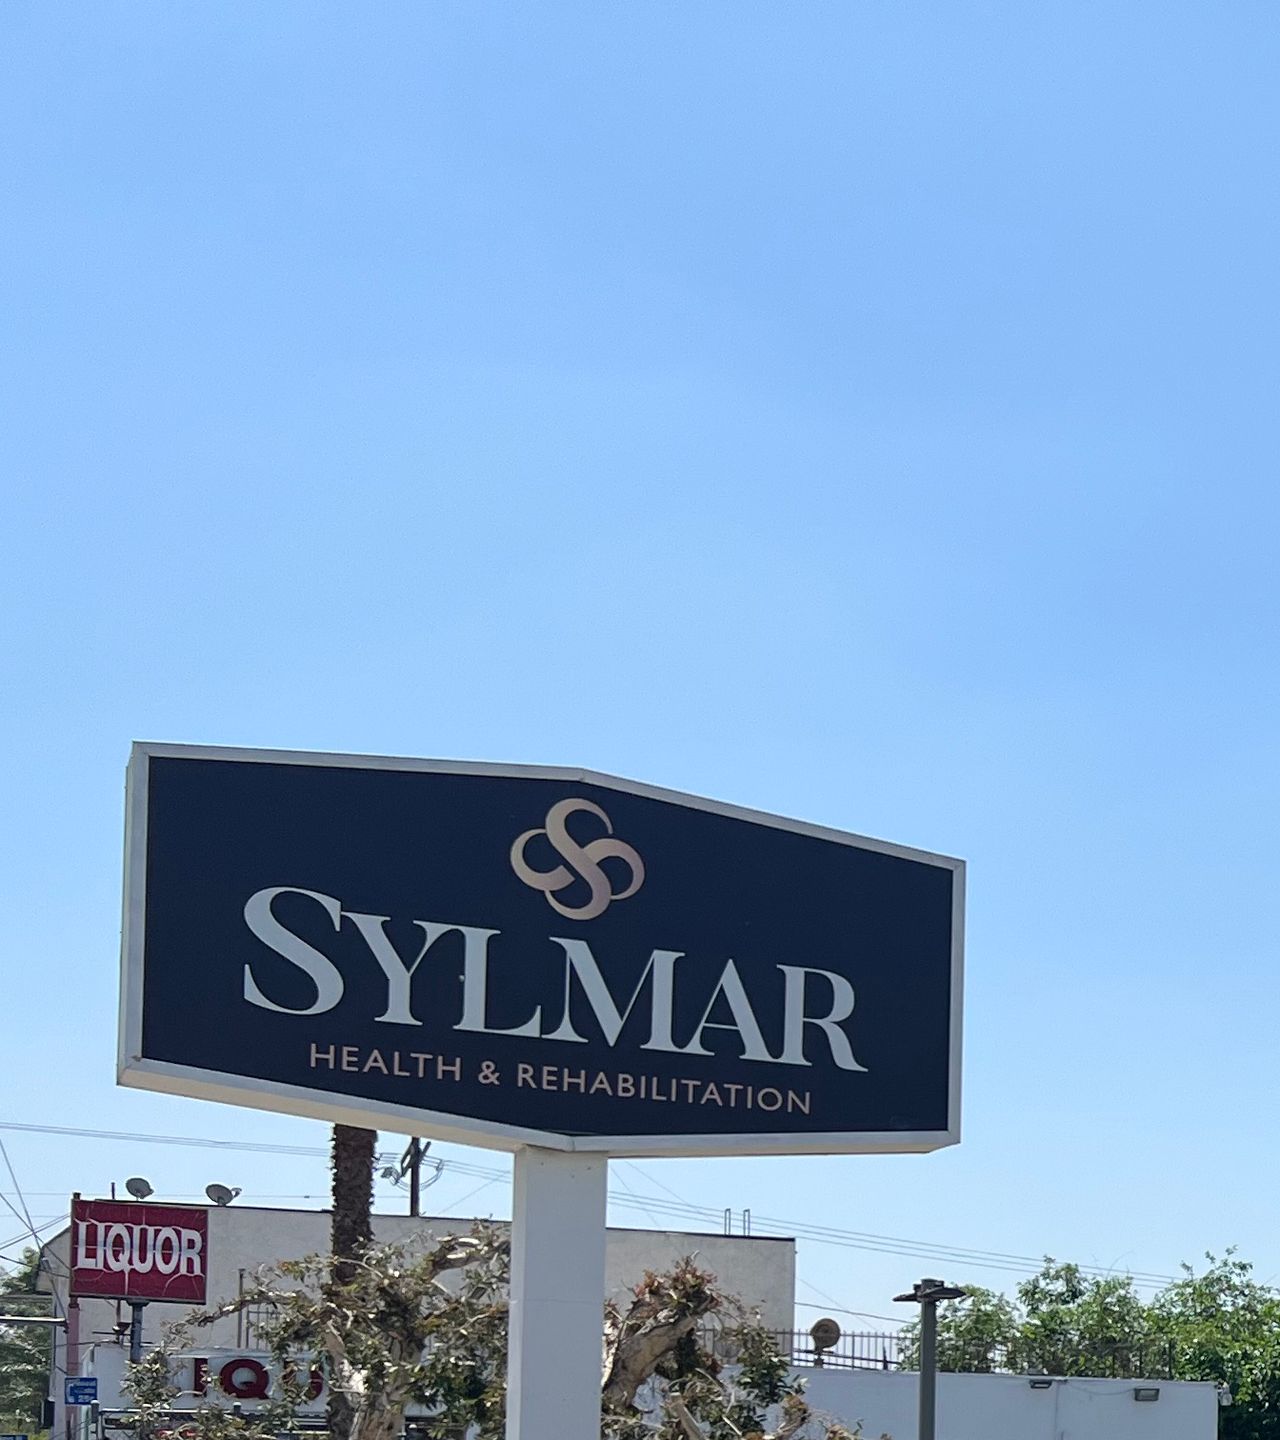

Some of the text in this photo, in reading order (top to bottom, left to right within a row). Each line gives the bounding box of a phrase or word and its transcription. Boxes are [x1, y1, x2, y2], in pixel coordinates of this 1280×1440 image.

[243, 886, 869, 1072] SYLMAR
[309, 1043, 811, 1115] HEALTH & REHABILITATION
[77, 1220, 203, 1275] LIQUOR
